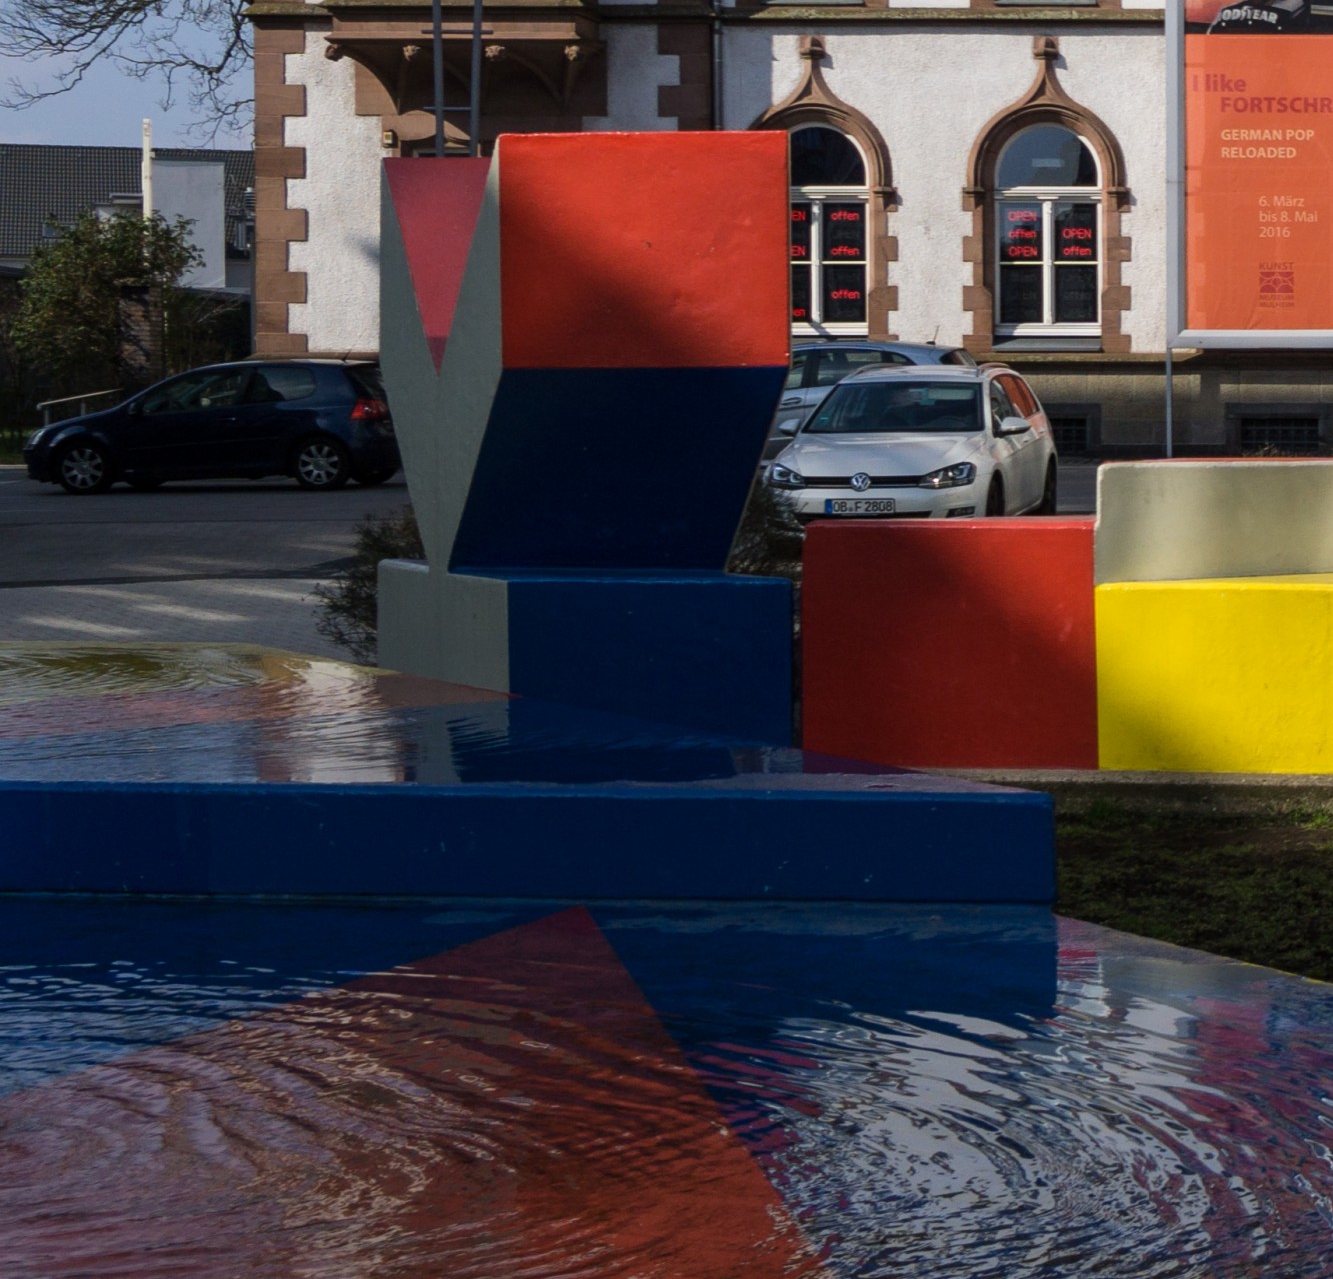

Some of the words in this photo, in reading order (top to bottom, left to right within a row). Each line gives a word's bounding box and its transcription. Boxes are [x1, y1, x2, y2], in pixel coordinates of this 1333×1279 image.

[1192, 75, 1199, 92] I
[1205, 74, 1247, 92] like
[1220, 129, 1283, 141] GERMAN
[1286, 129, 1315, 141] POP
[1221, 146, 1297, 159] RELOADED
[1259, 195, 1270, 207] 6.
[830, 211, 860, 221] offen
[1008, 211, 1037, 222] OPEN
[1259, 210, 1278, 223] bis
[1280, 211, 1291, 222] 8.
[1295, 211, 1319, 223] Mai
[1008, 228, 1037, 239] offen
[1062, 228, 1092, 239] OPEN
[1259, 226, 1291, 238] 2016
[830, 245, 860, 256] offen
[1008, 246, 1038, 257] OPEN
[1062, 245, 1092, 256] offen
[831, 289, 861, 300] offen
